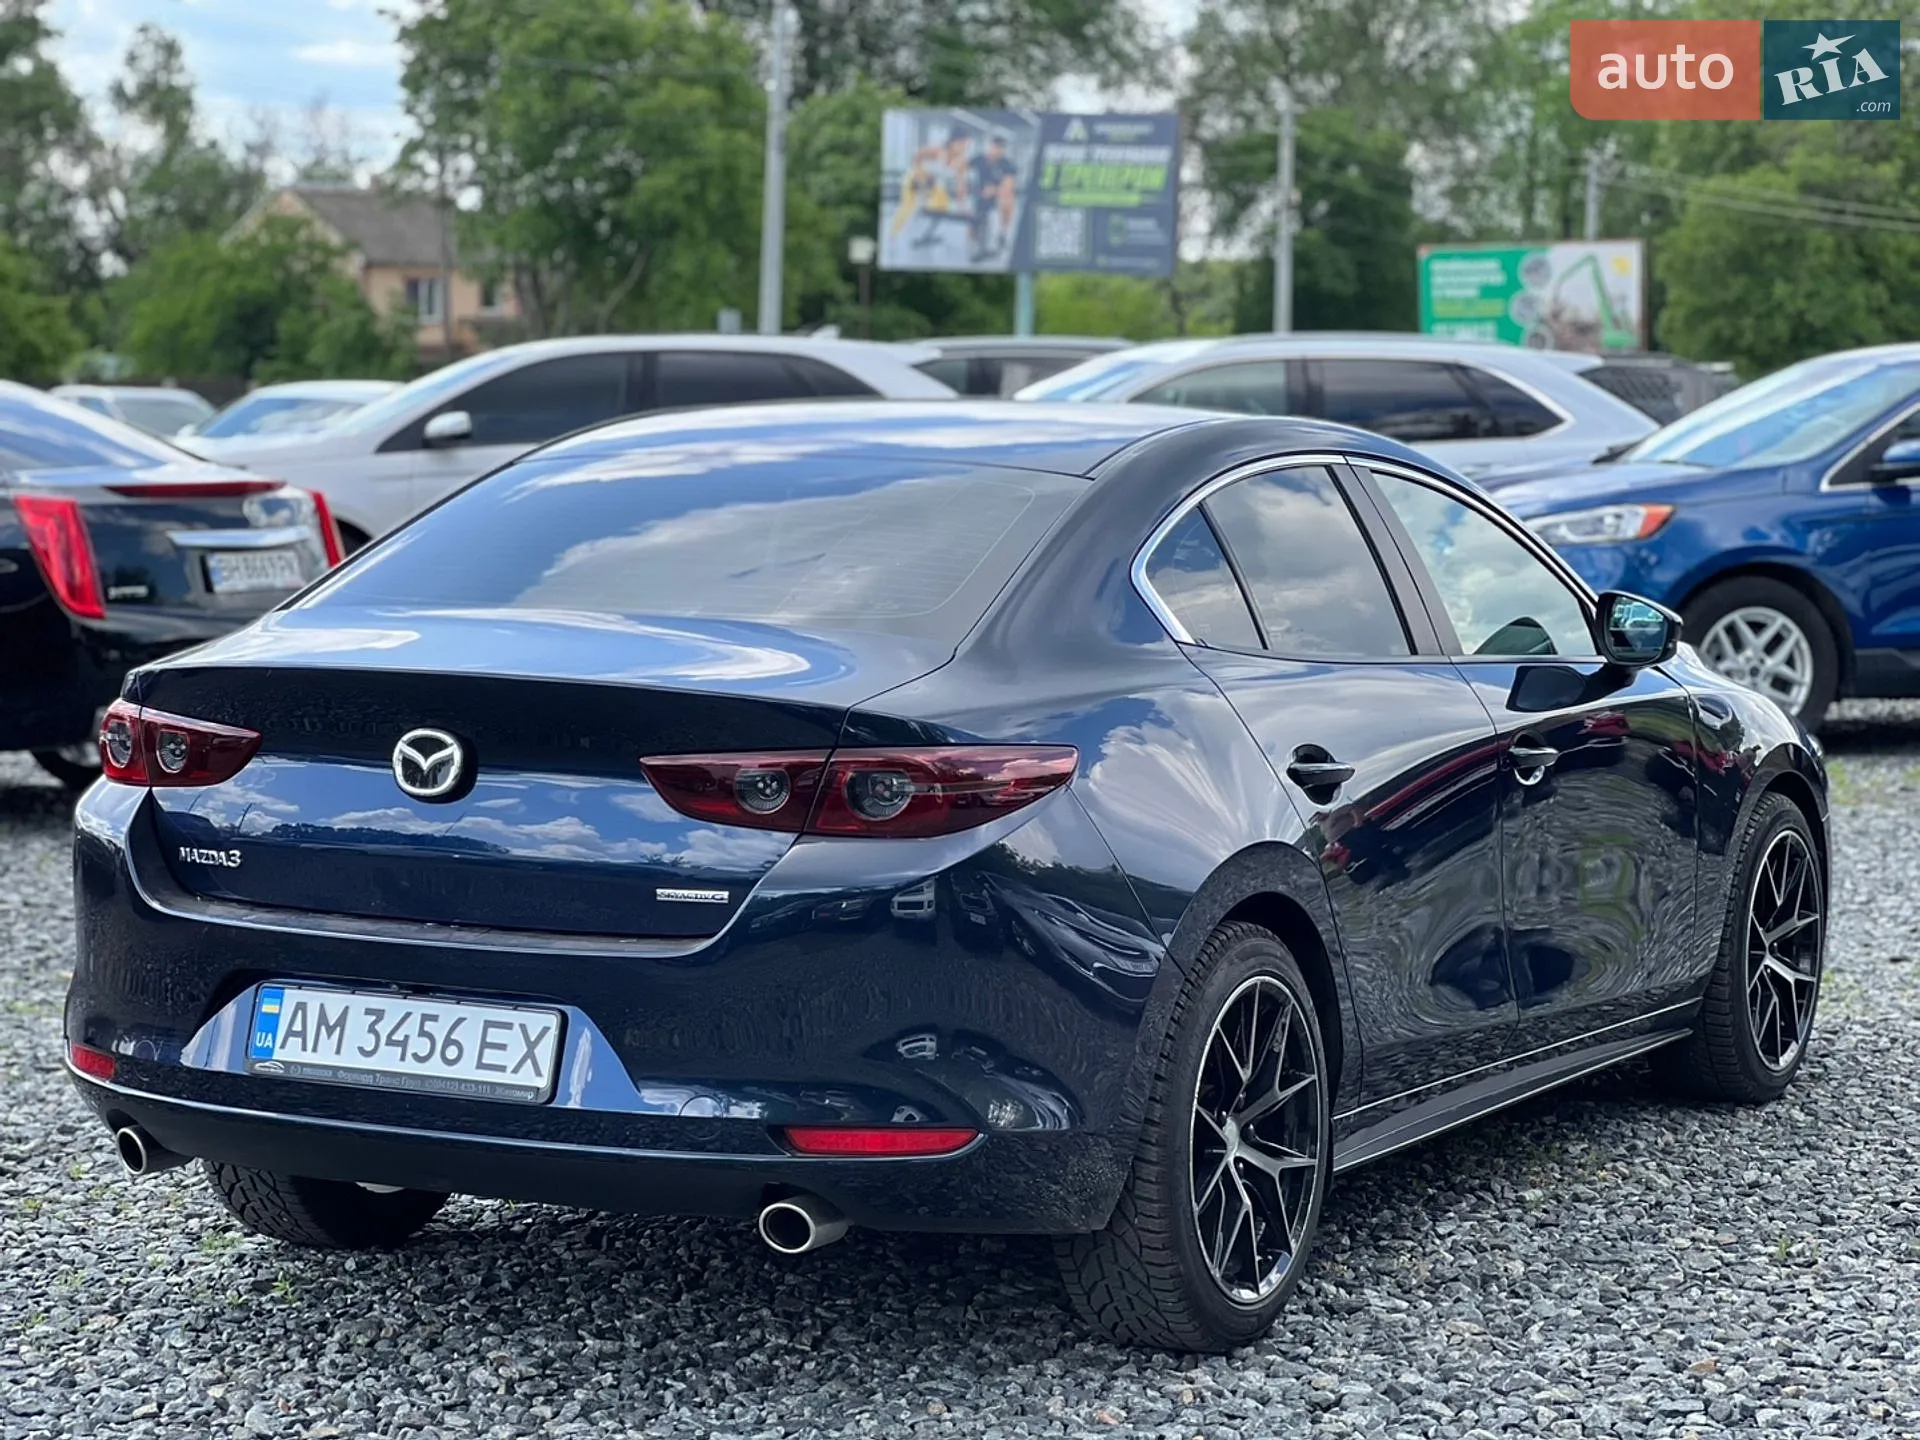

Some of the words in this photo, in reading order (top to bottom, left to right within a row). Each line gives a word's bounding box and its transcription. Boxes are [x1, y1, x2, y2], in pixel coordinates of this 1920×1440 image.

[179, 846, 242, 868] MAZDA3
[255, 1031, 275, 1049] UA
[279, 1001, 350, 1056] AM
[356, 1007, 468, 1067] 3456
[474, 1019, 551, 1078] EX
